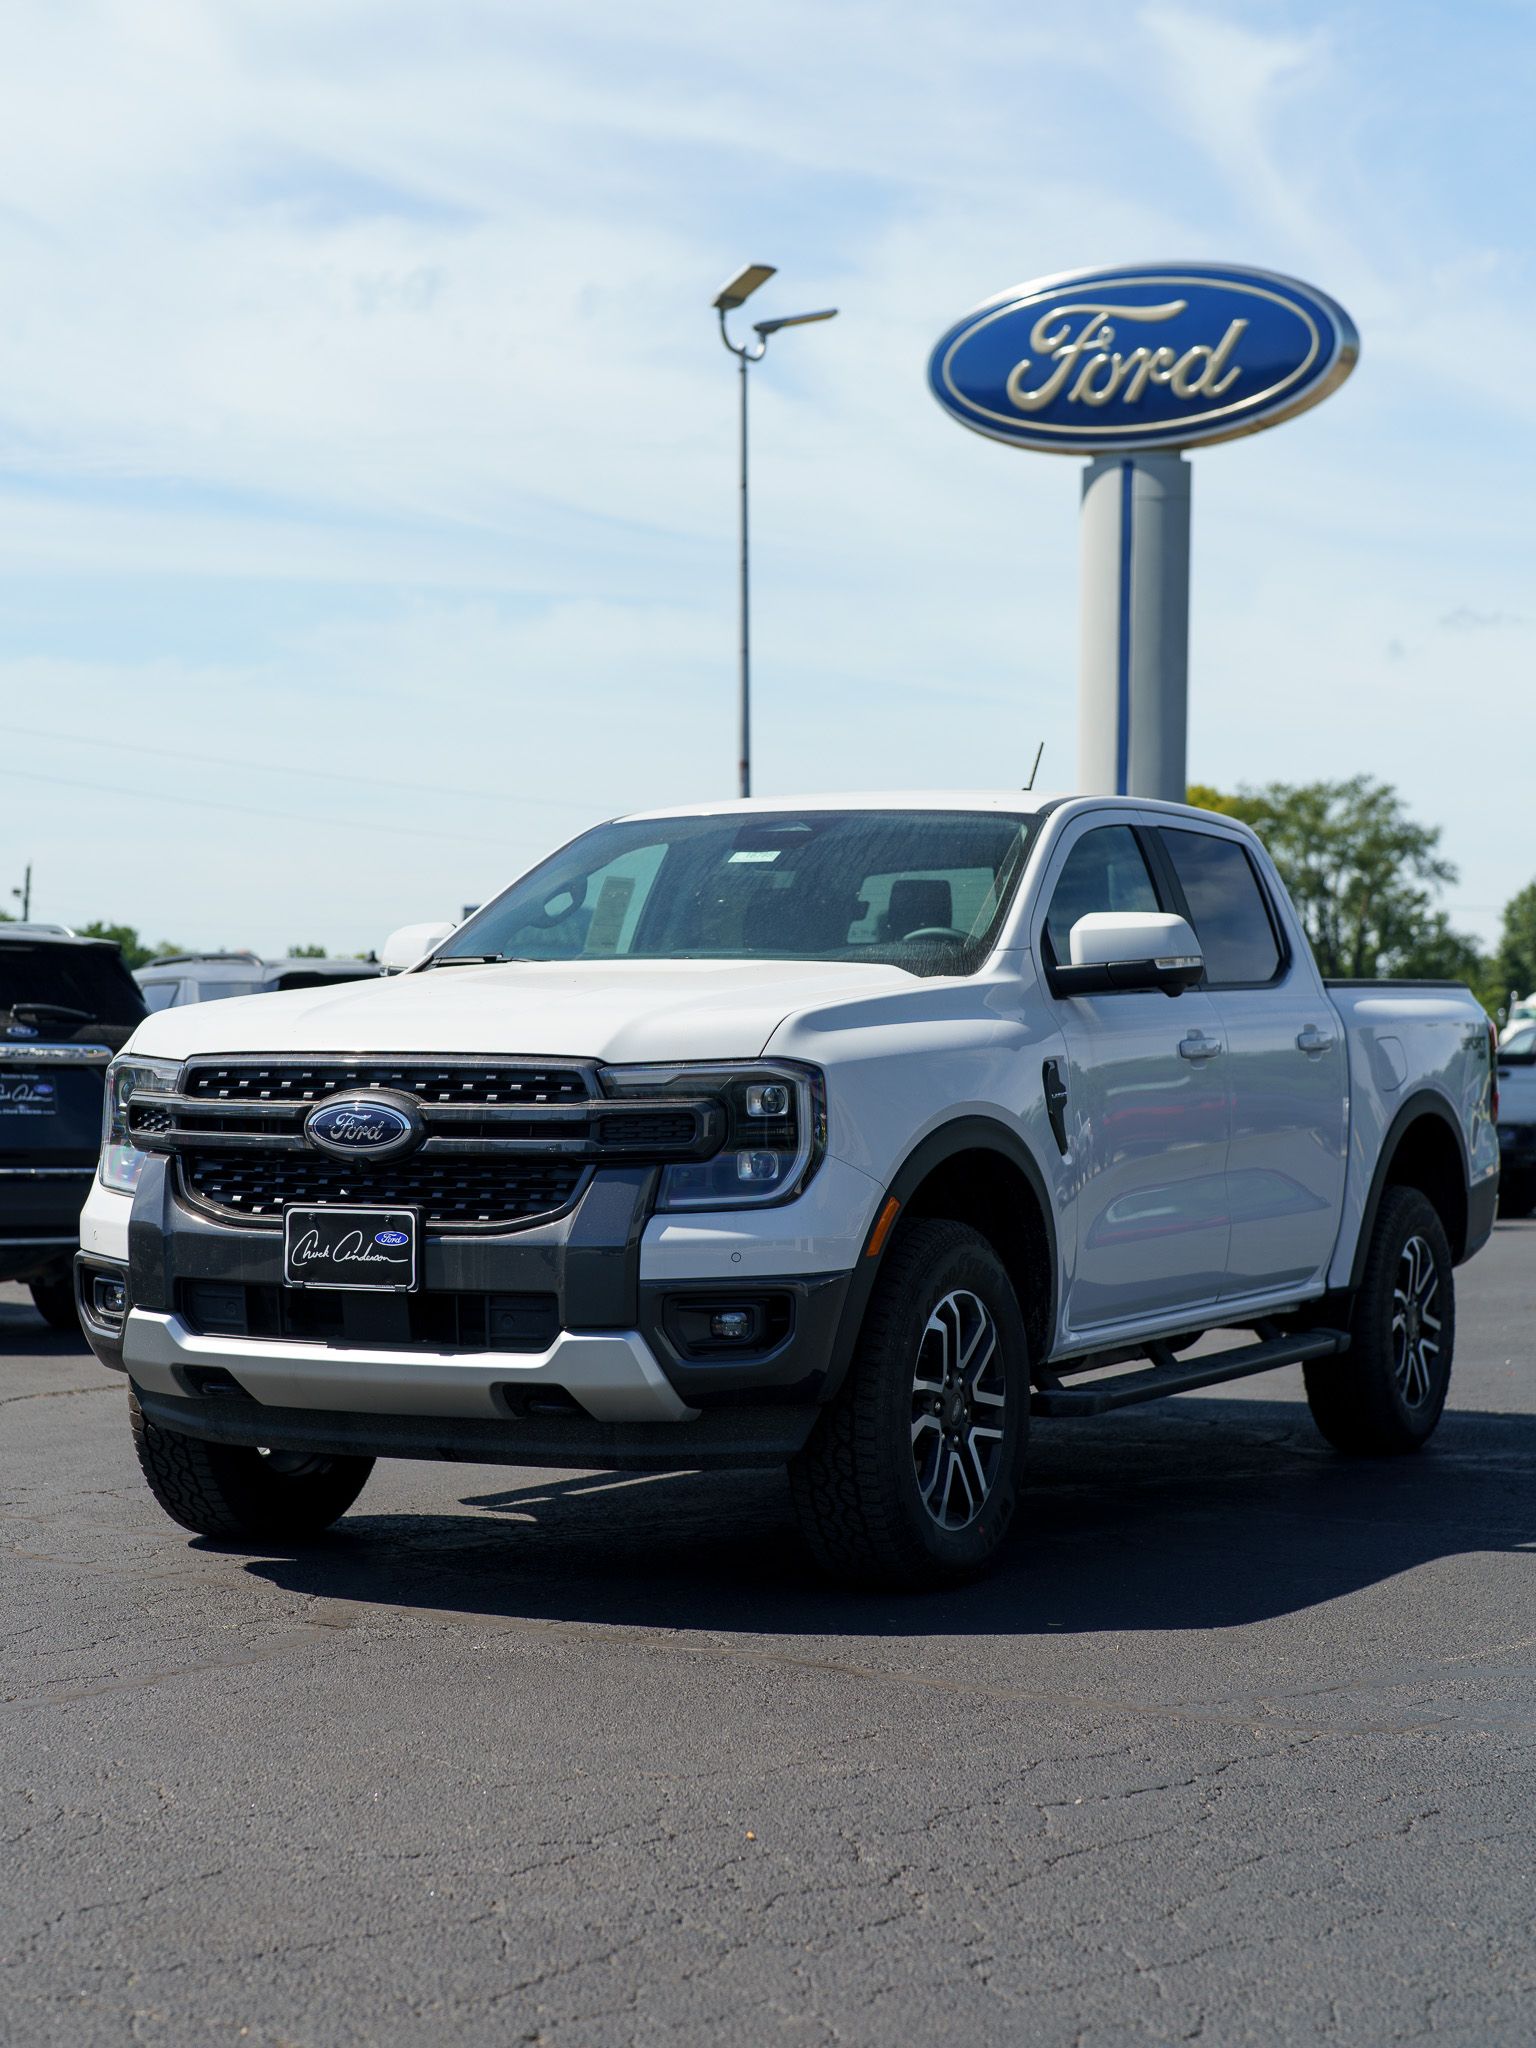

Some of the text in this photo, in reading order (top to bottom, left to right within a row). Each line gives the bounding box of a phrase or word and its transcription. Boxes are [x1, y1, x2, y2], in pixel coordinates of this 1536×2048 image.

[1006, 299, 1249, 412] Ford
[329, 1112, 385, 1140] Ford
[291, 1229, 409, 1266] Chuck Anderson
[380, 1233, 402, 1244] Ford
